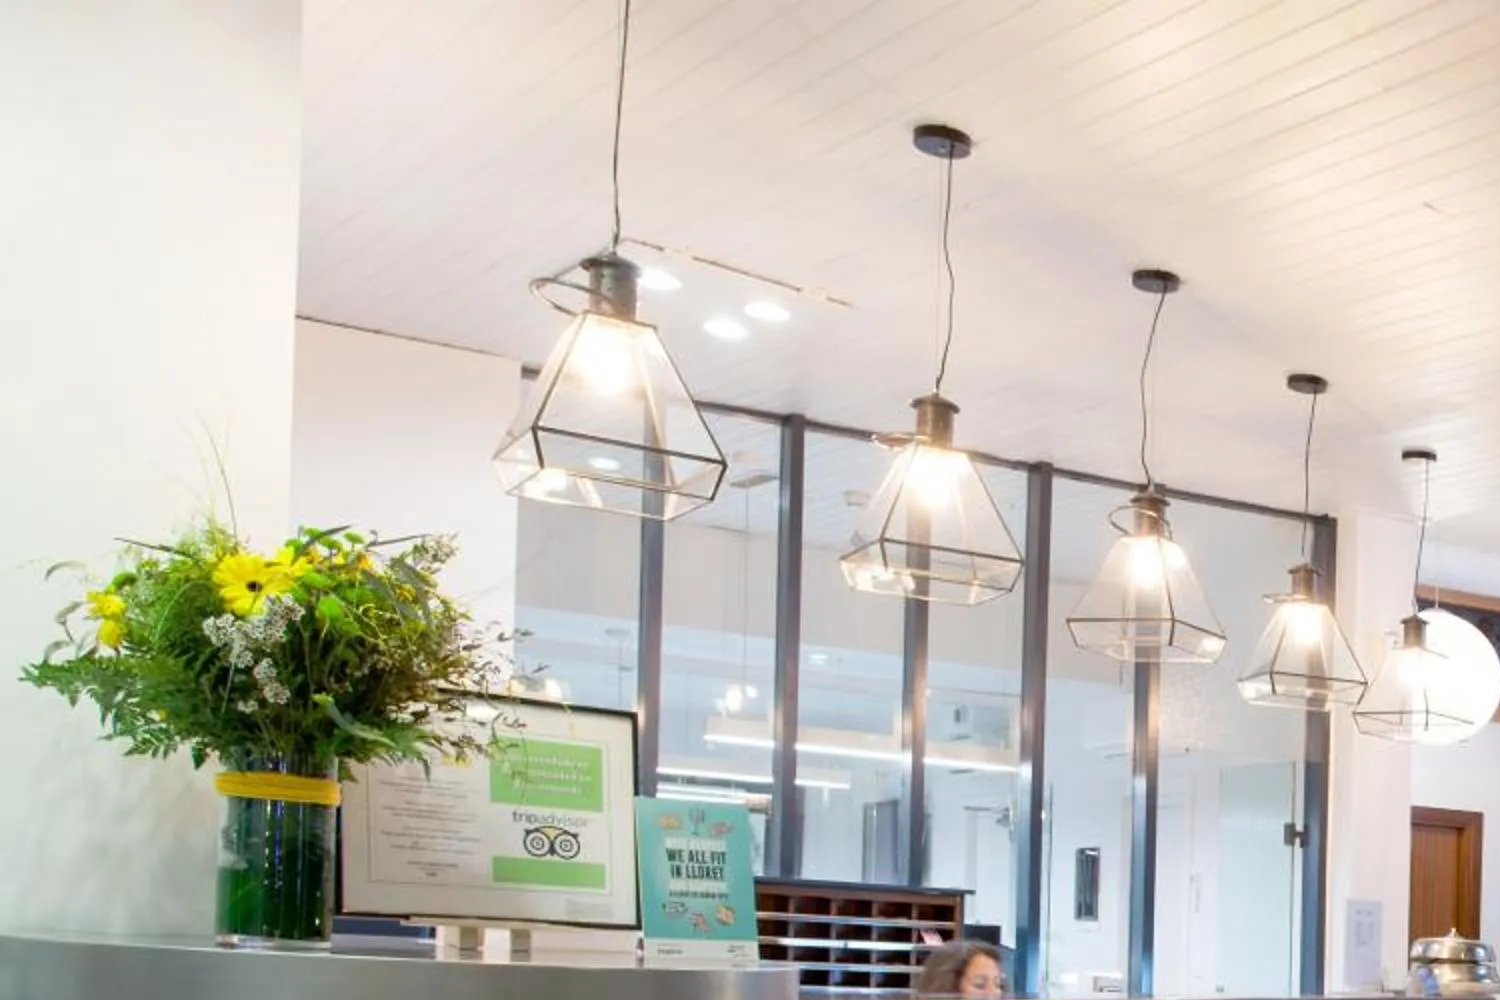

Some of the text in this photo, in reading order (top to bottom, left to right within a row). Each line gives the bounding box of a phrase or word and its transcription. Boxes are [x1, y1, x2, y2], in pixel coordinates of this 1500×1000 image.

[666, 848, 727, 865] WE ALL FIT
[671, 864, 724, 880] IN LLORET
